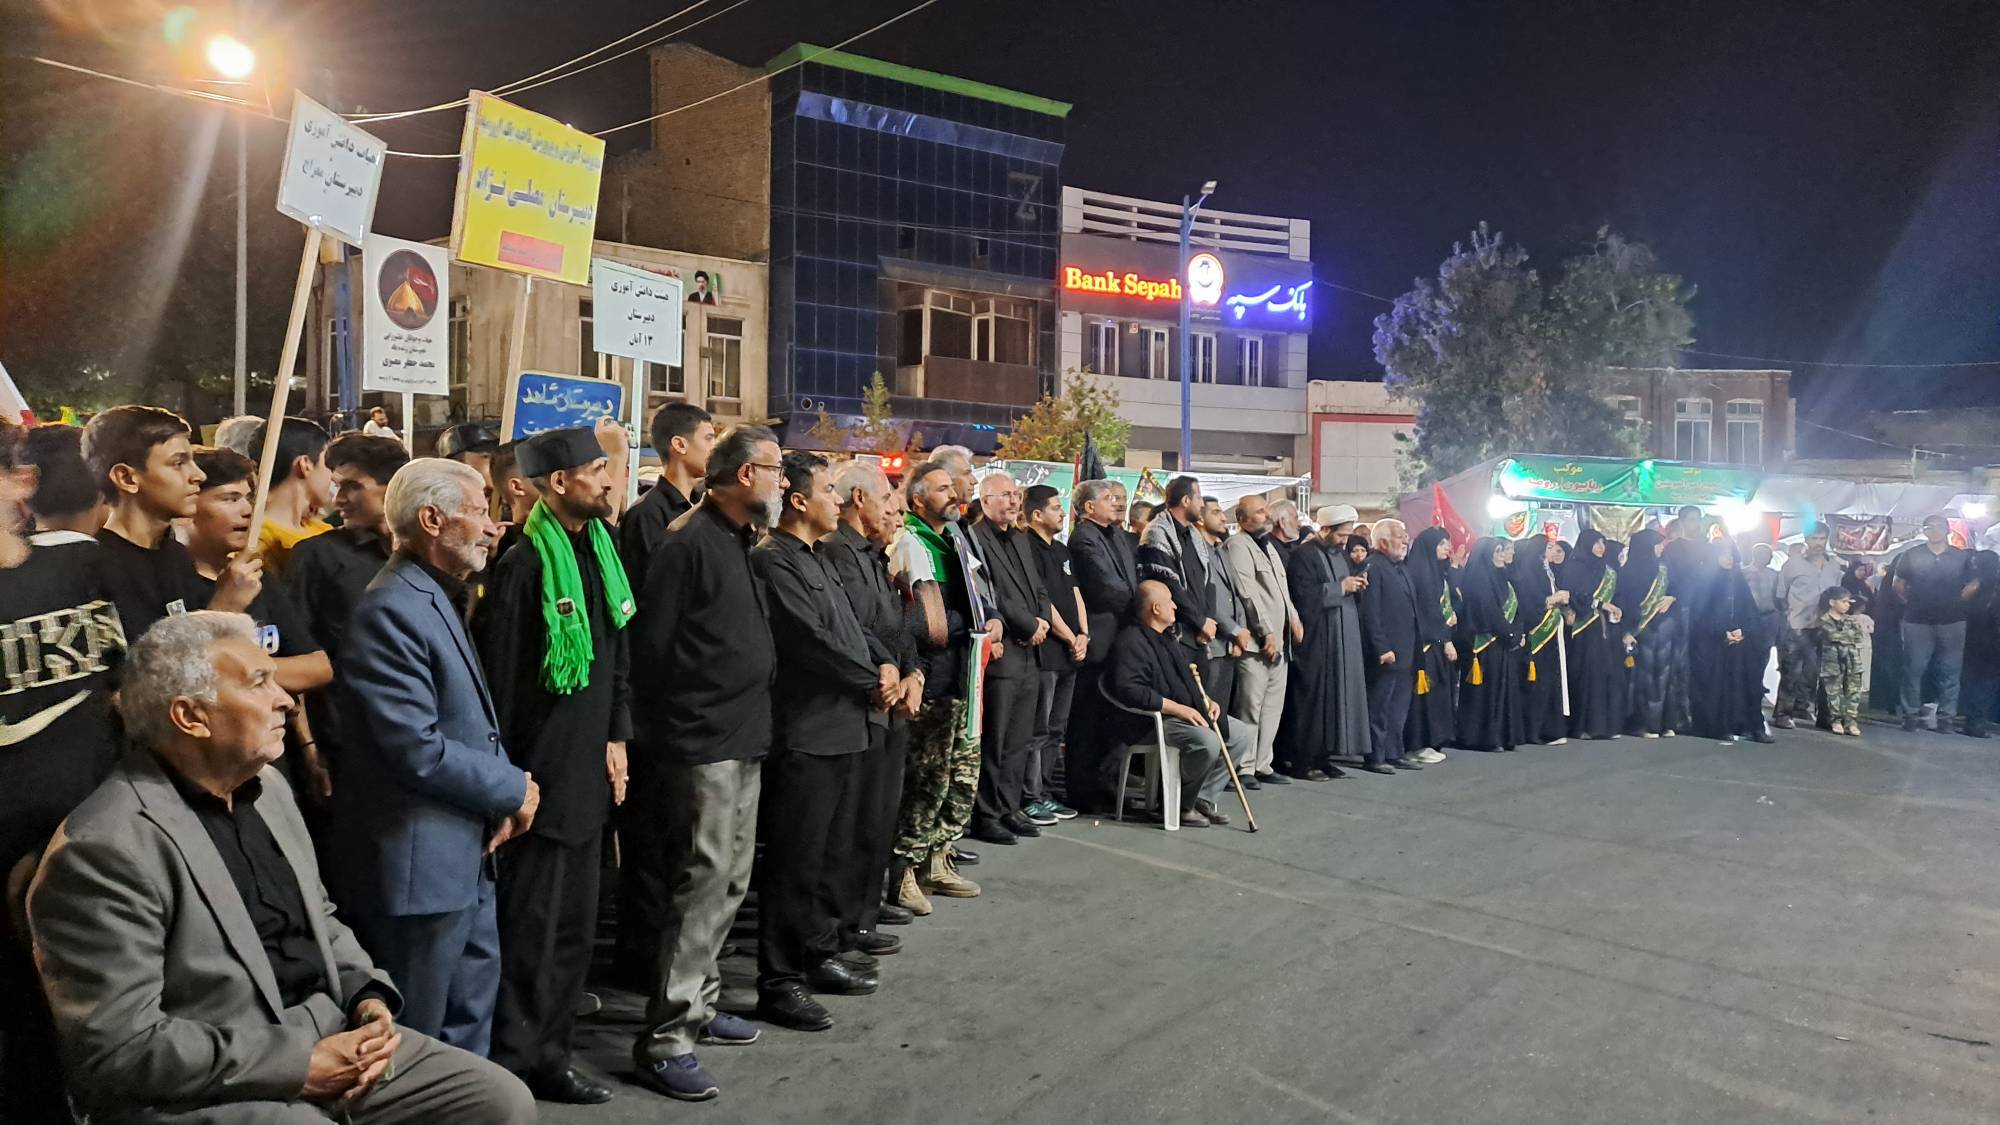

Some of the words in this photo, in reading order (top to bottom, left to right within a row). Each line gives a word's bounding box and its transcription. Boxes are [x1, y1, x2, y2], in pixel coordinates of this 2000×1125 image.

[330, 137, 355, 153] دانش
[324, 170, 363, 197] دبیرستان
[548, 189, 592, 225] دبیرستان
[611, 280, 633, 294] آموزی
[635, 284, 653, 298] دانش
[1065, 267, 1121, 293] Bank
[1124, 273, 1182, 301] Sepah
[1226, 284, 1281, 320] سپه
[1267, 280, 1313, 320] بانک
[627, 307, 655, 325] دبیرستان
[629, 332, 642, 346] آبان
[644, 334, 653, 346] ۱۳
[520, 382, 562, 405] شاهد
[557, 388, 613, 421] دبیرستان
[1552, 462, 1584, 476] موکب
